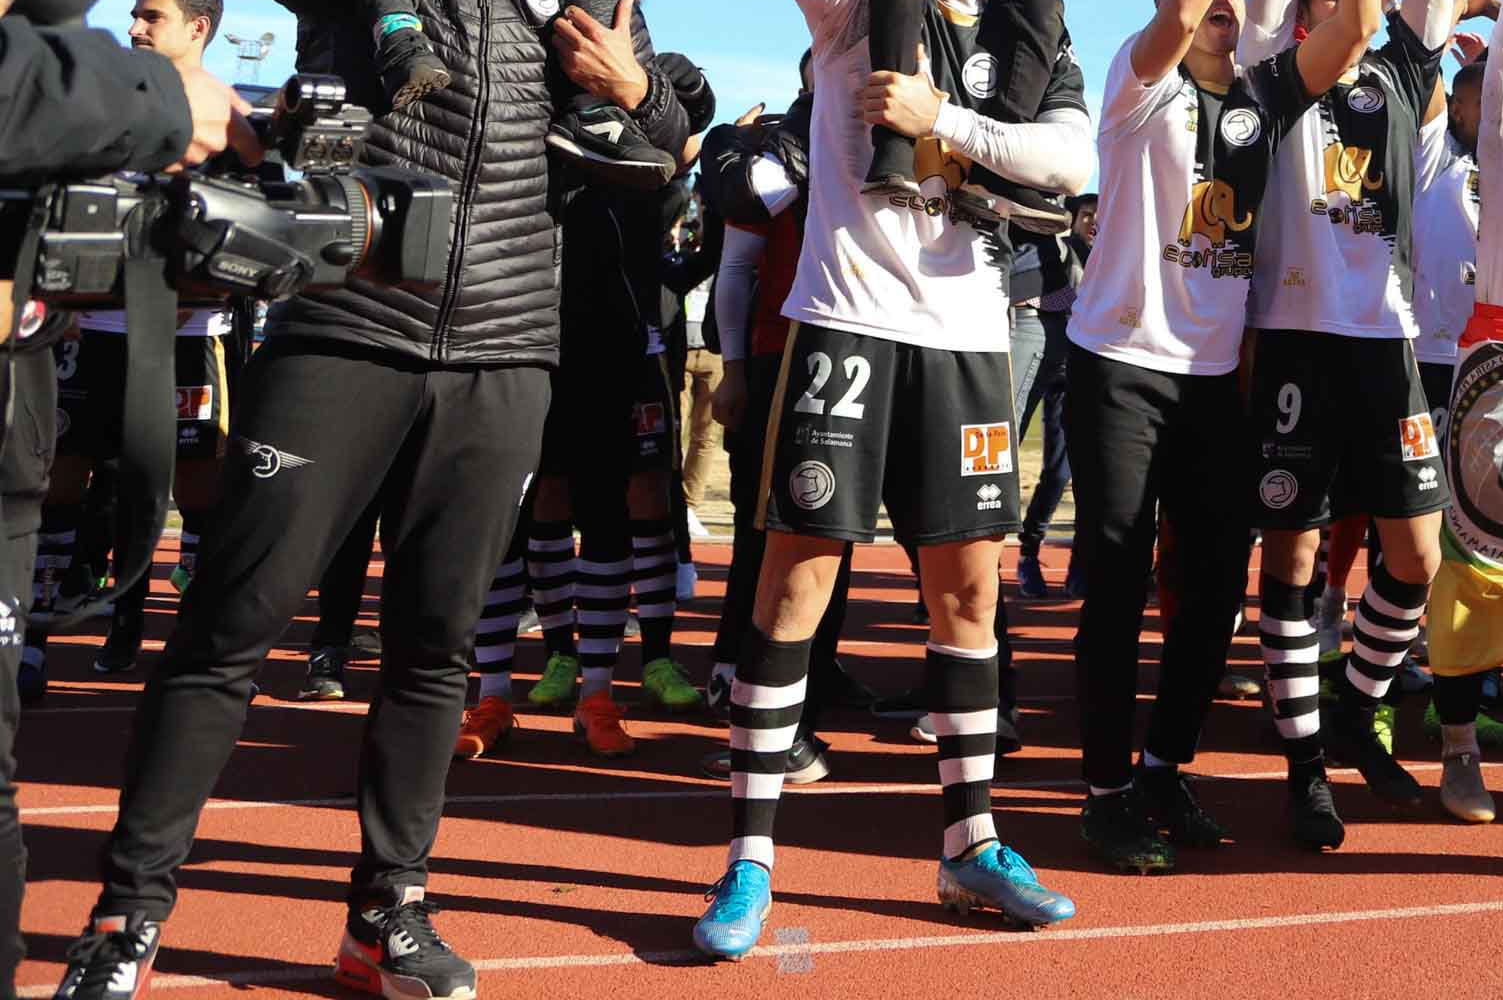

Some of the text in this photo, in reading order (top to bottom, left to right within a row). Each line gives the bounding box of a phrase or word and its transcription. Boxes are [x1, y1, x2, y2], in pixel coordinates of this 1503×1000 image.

[1310, 198, 1383, 225] eorisa
[1163, 244, 1252, 268] ecorisa
[217, 261, 258, 277] SONY
[794, 352, 871, 419] 22
[1276, 383, 1302, 433] 9
[811, 429, 854, 440] Ayuntamiento
[820, 438, 853, 447] Salamanca
